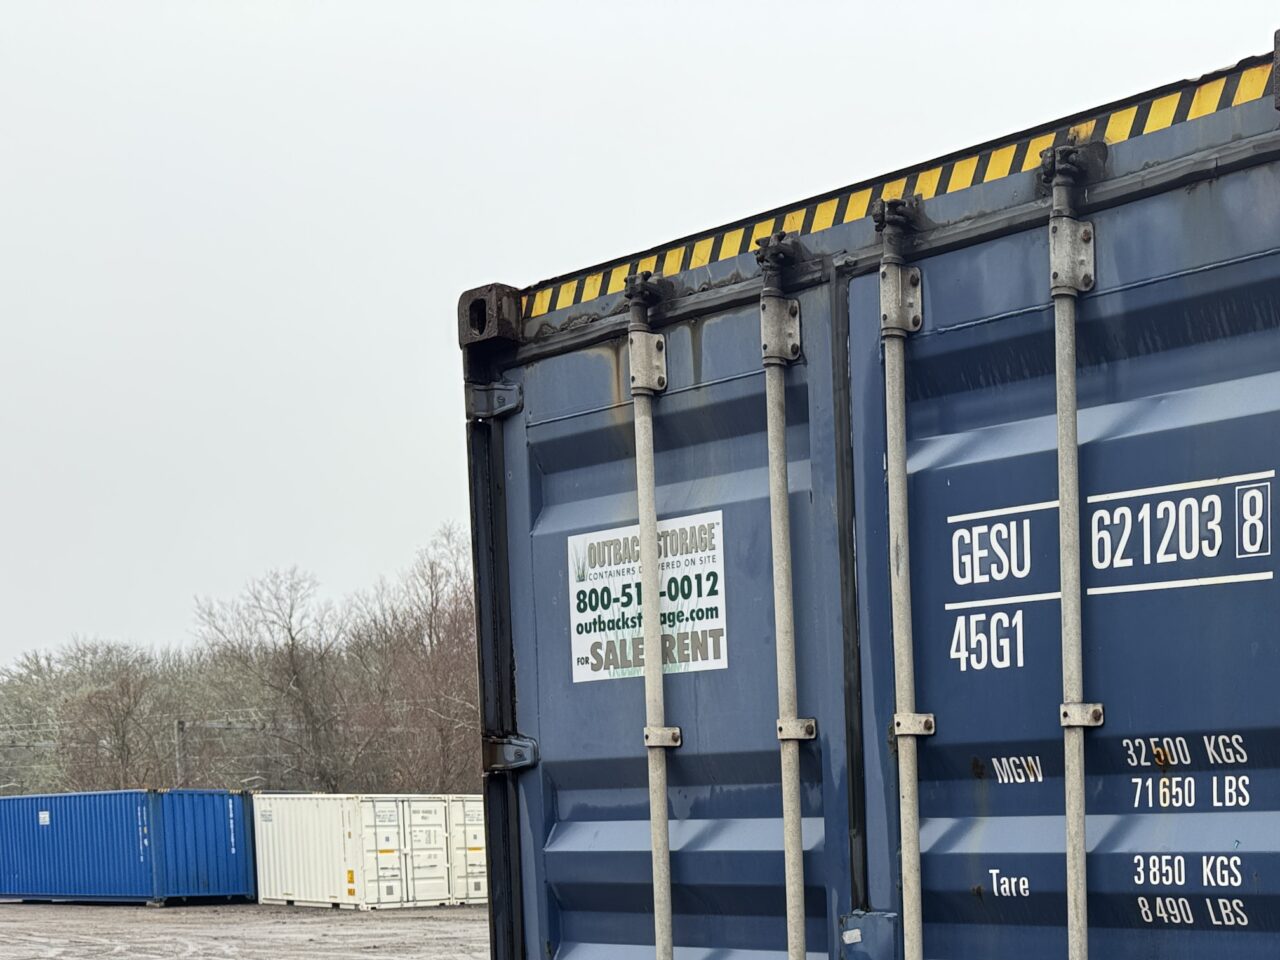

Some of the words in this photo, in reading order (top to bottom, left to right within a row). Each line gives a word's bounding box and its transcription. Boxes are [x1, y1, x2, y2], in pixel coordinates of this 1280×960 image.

[587, 535, 641, 569] OUTBAC
[951, 519, 1031, 585] GESU
[1091, 494, 1222, 569] 621203
[1242, 489, 1264, 553] 8
[588, 566, 636, 582] CONTAINERS
[684, 557, 696, 567] ON
[699, 554, 716, 565] SITE
[576, 571, 719, 613] 800-51-0012
[577, 656, 589, 666] FOR
[590, 637, 644, 672] SALE
[660, 628, 724, 665] RENT
[950, 609, 1024, 672] 45G1
[1204, 734, 1248, 764] KGS
[992, 756, 1044, 784] MGW
[1212, 776, 1250, 807] LBS
[989, 869, 1030, 897] Tare
[1202, 856, 1242, 887] KGS
[1206, 898, 1248, 926] LBS
